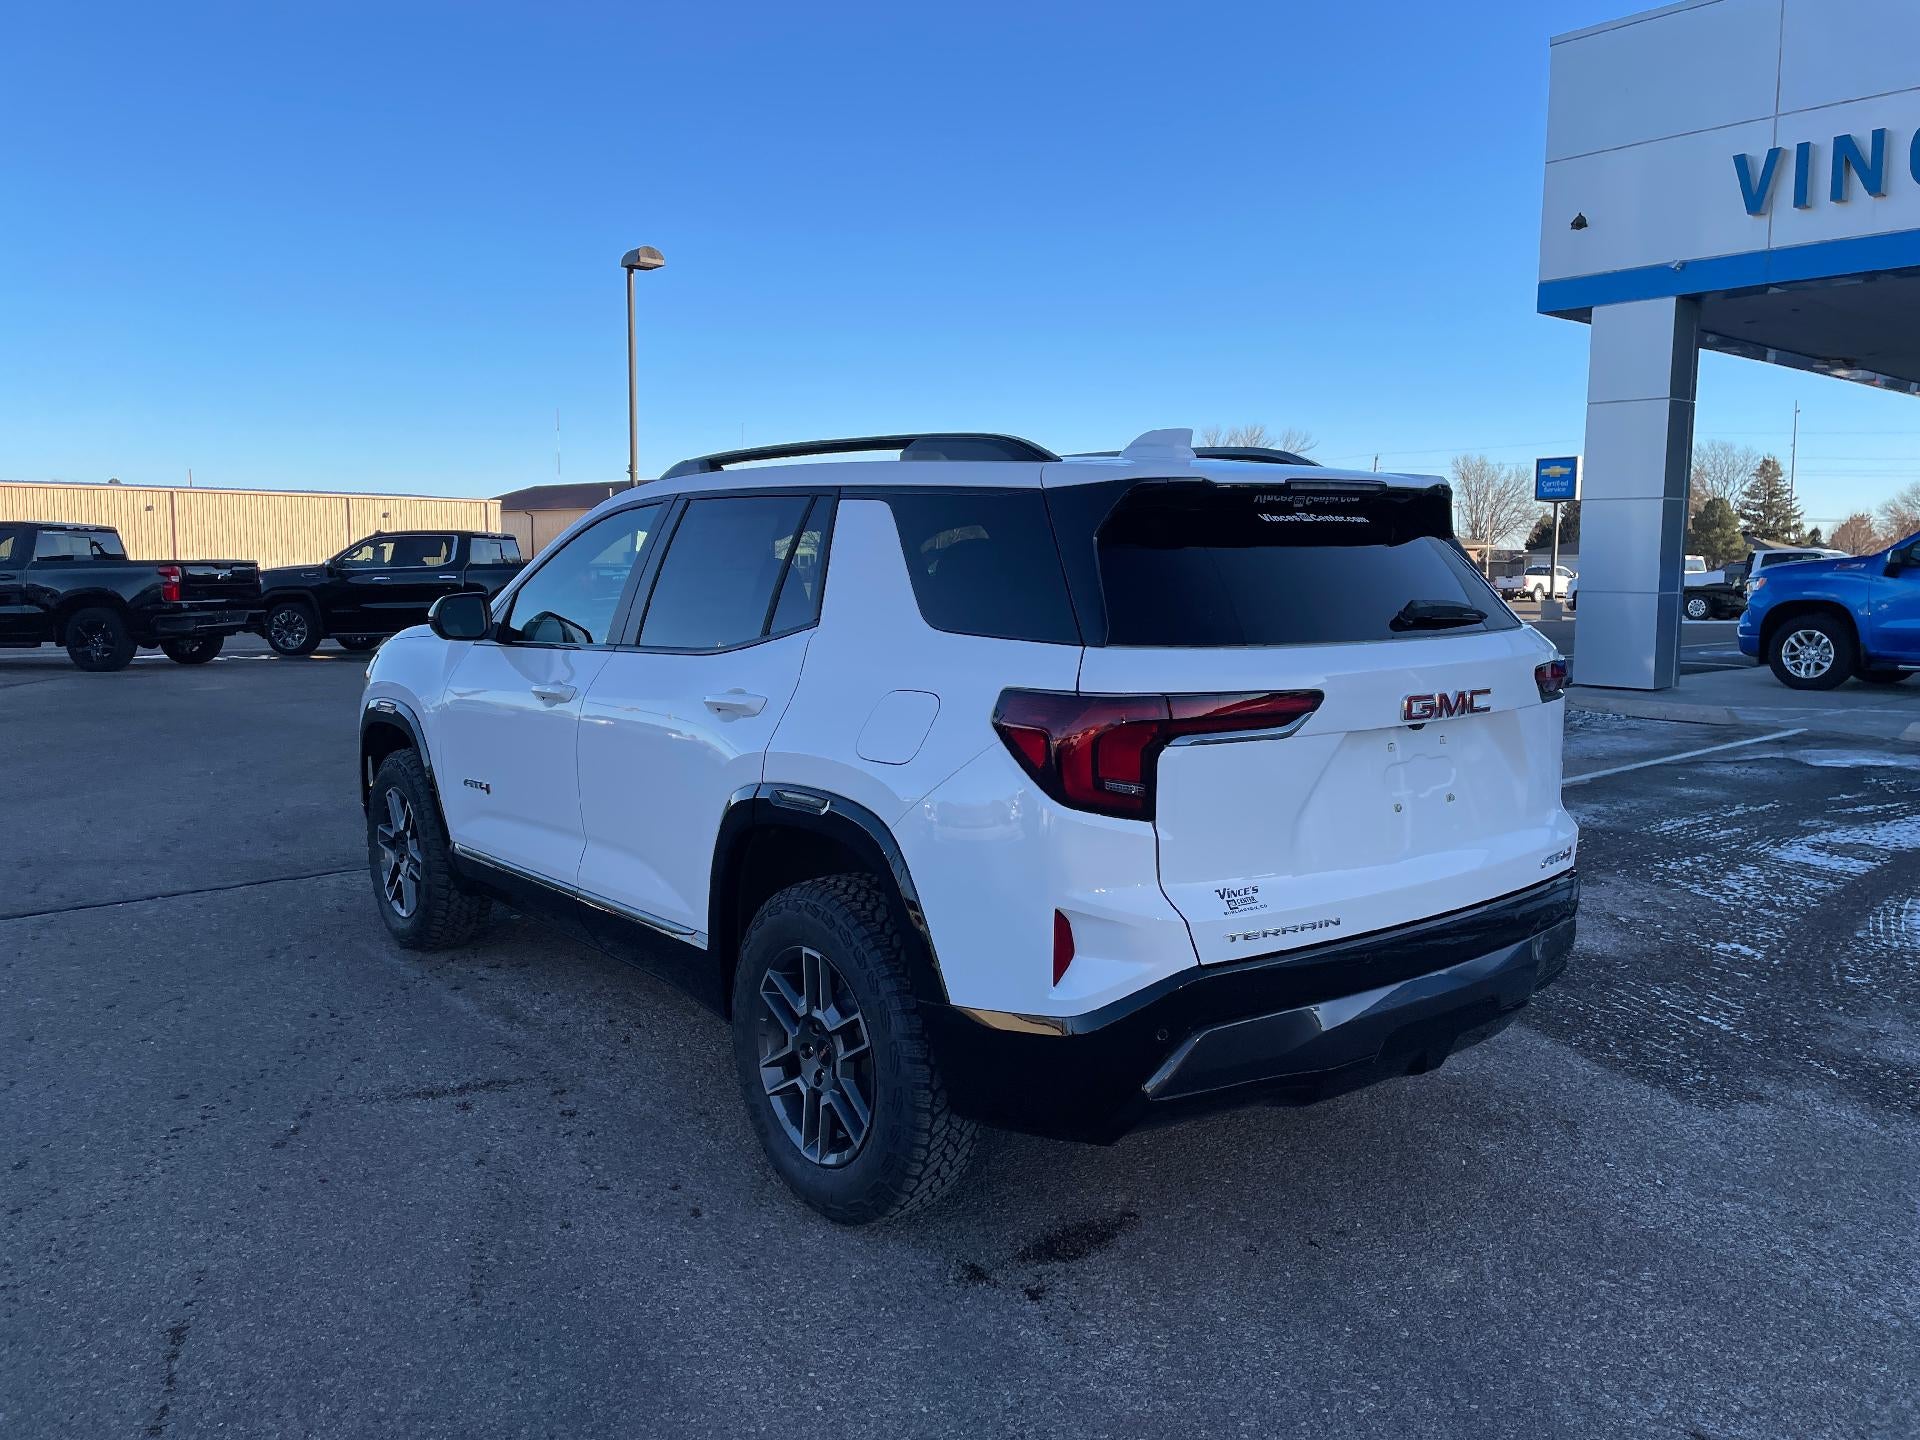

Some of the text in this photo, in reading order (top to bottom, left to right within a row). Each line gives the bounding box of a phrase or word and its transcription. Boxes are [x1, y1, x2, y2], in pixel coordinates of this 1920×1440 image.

[1733, 127, 1920, 216] VIN
[1541, 480, 1569, 488] Certified
[1401, 688, 1492, 721] GMC
[463, 779, 491, 795] AT4
[1224, 917, 1342, 943] TERRAIN
